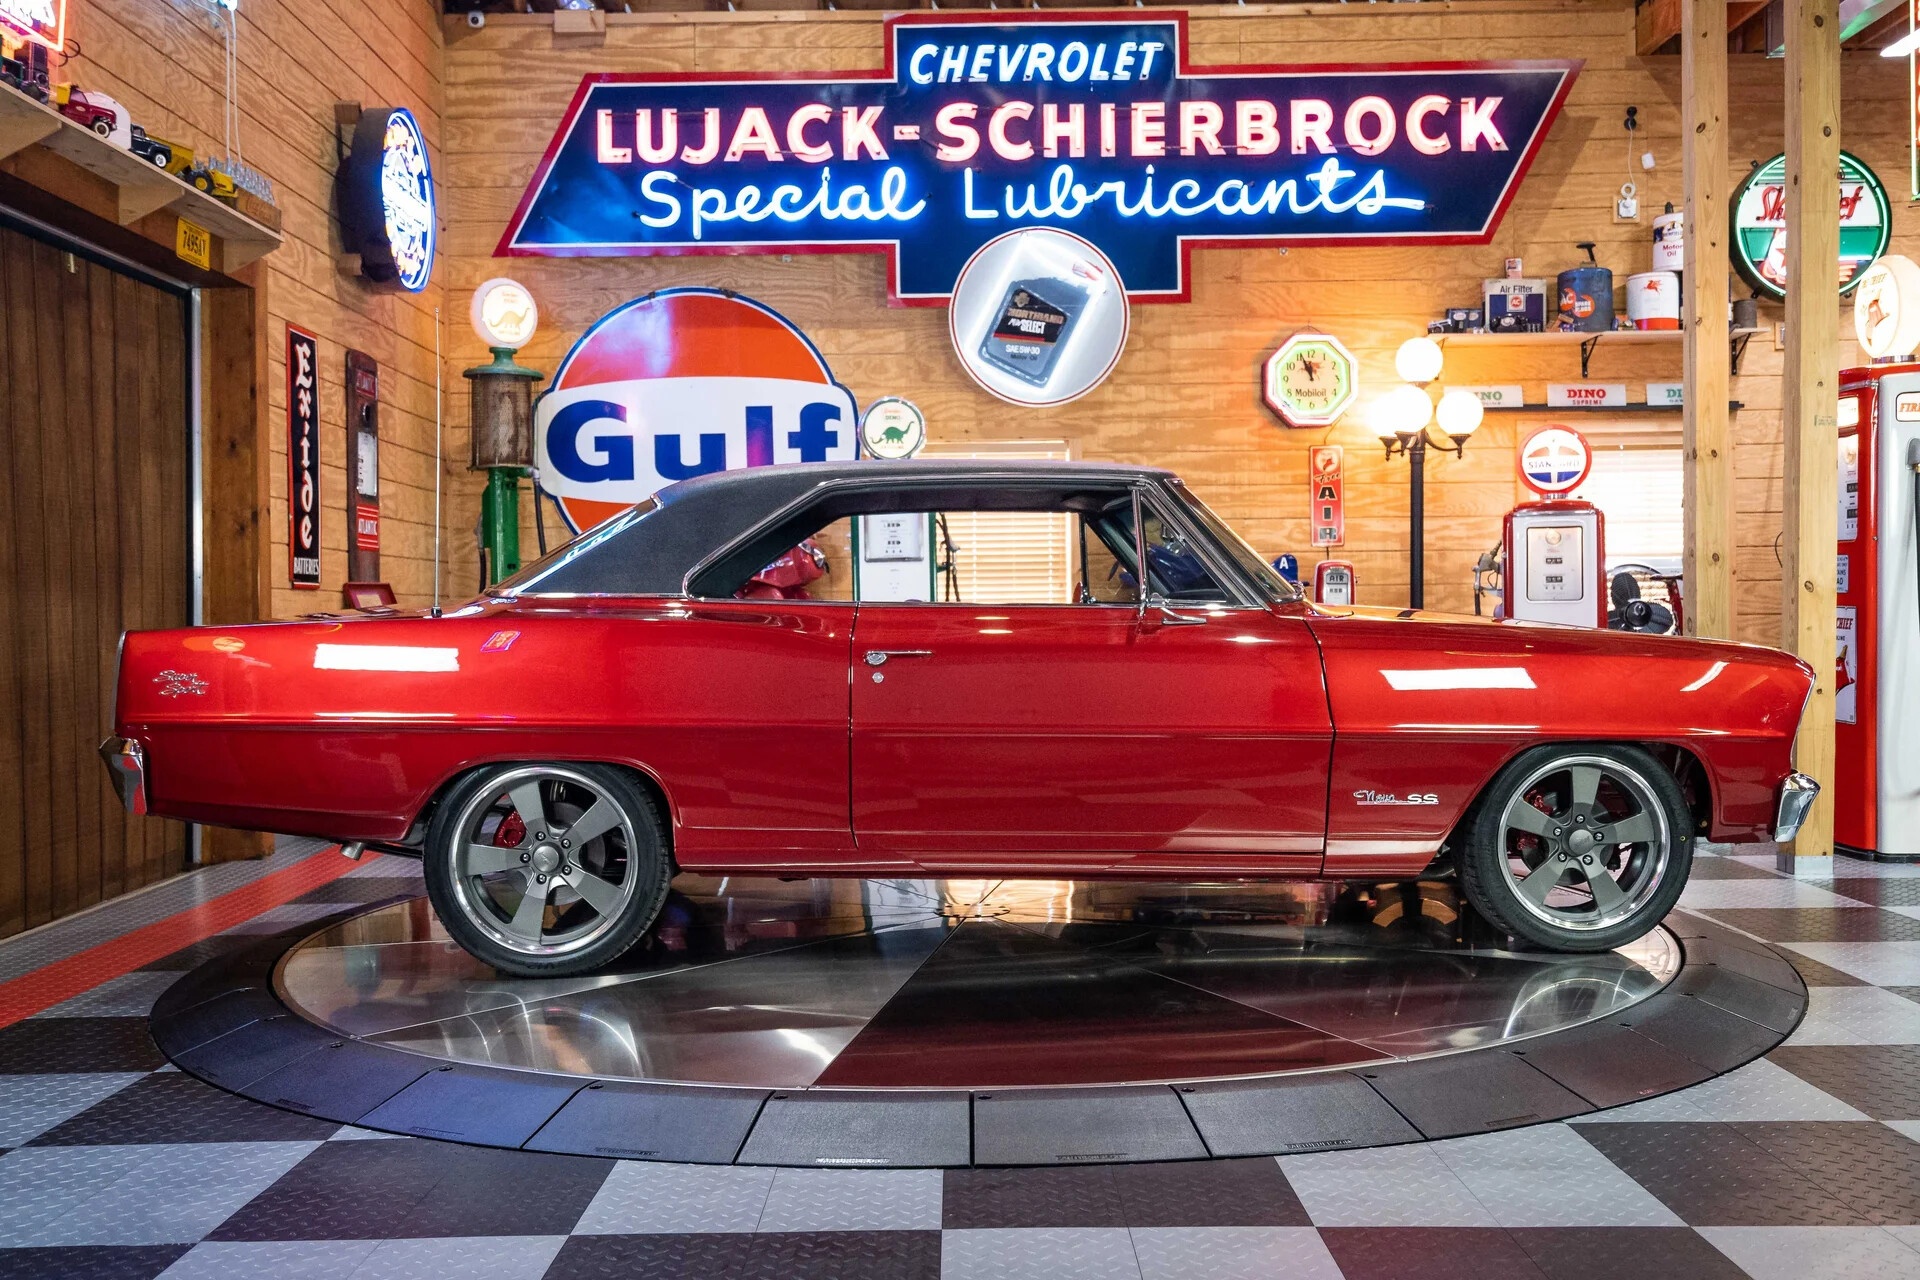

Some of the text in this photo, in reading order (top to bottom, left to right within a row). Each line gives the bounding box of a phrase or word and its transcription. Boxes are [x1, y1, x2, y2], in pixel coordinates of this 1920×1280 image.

[909, 42, 1165, 84] CHEVROLET
[597, 94, 1510, 165] LUJACK-SCHIERBROCK
[640, 156, 1426, 240] Special Lubricants
[1500, 285, 1533, 293] Air Filter
[1020, 319, 1047, 334] SELECT
[1005, 344, 1040, 355] SAE 5W-30
[1307, 349, 1316, 358] 12
[1286, 362, 1296, 370] 10
[1332, 362, 1337, 370] 2
[1283, 375, 1289, 383] 9
[1287, 389, 1292, 397] 8
[1295, 388, 1327, 398] Mobiloil
[1332, 388, 1337, 396] 4
[1567, 389, 1607, 399] DINO
[1309, 401, 1315, 409] 6
[546, 400, 842, 483] Gulf
[1318, 486, 1337, 540] AIR
[294, 557, 319, 575] BATTERIES
[1279, 557, 1289, 569] A
[1353, 790, 1438, 804] Nova SS
